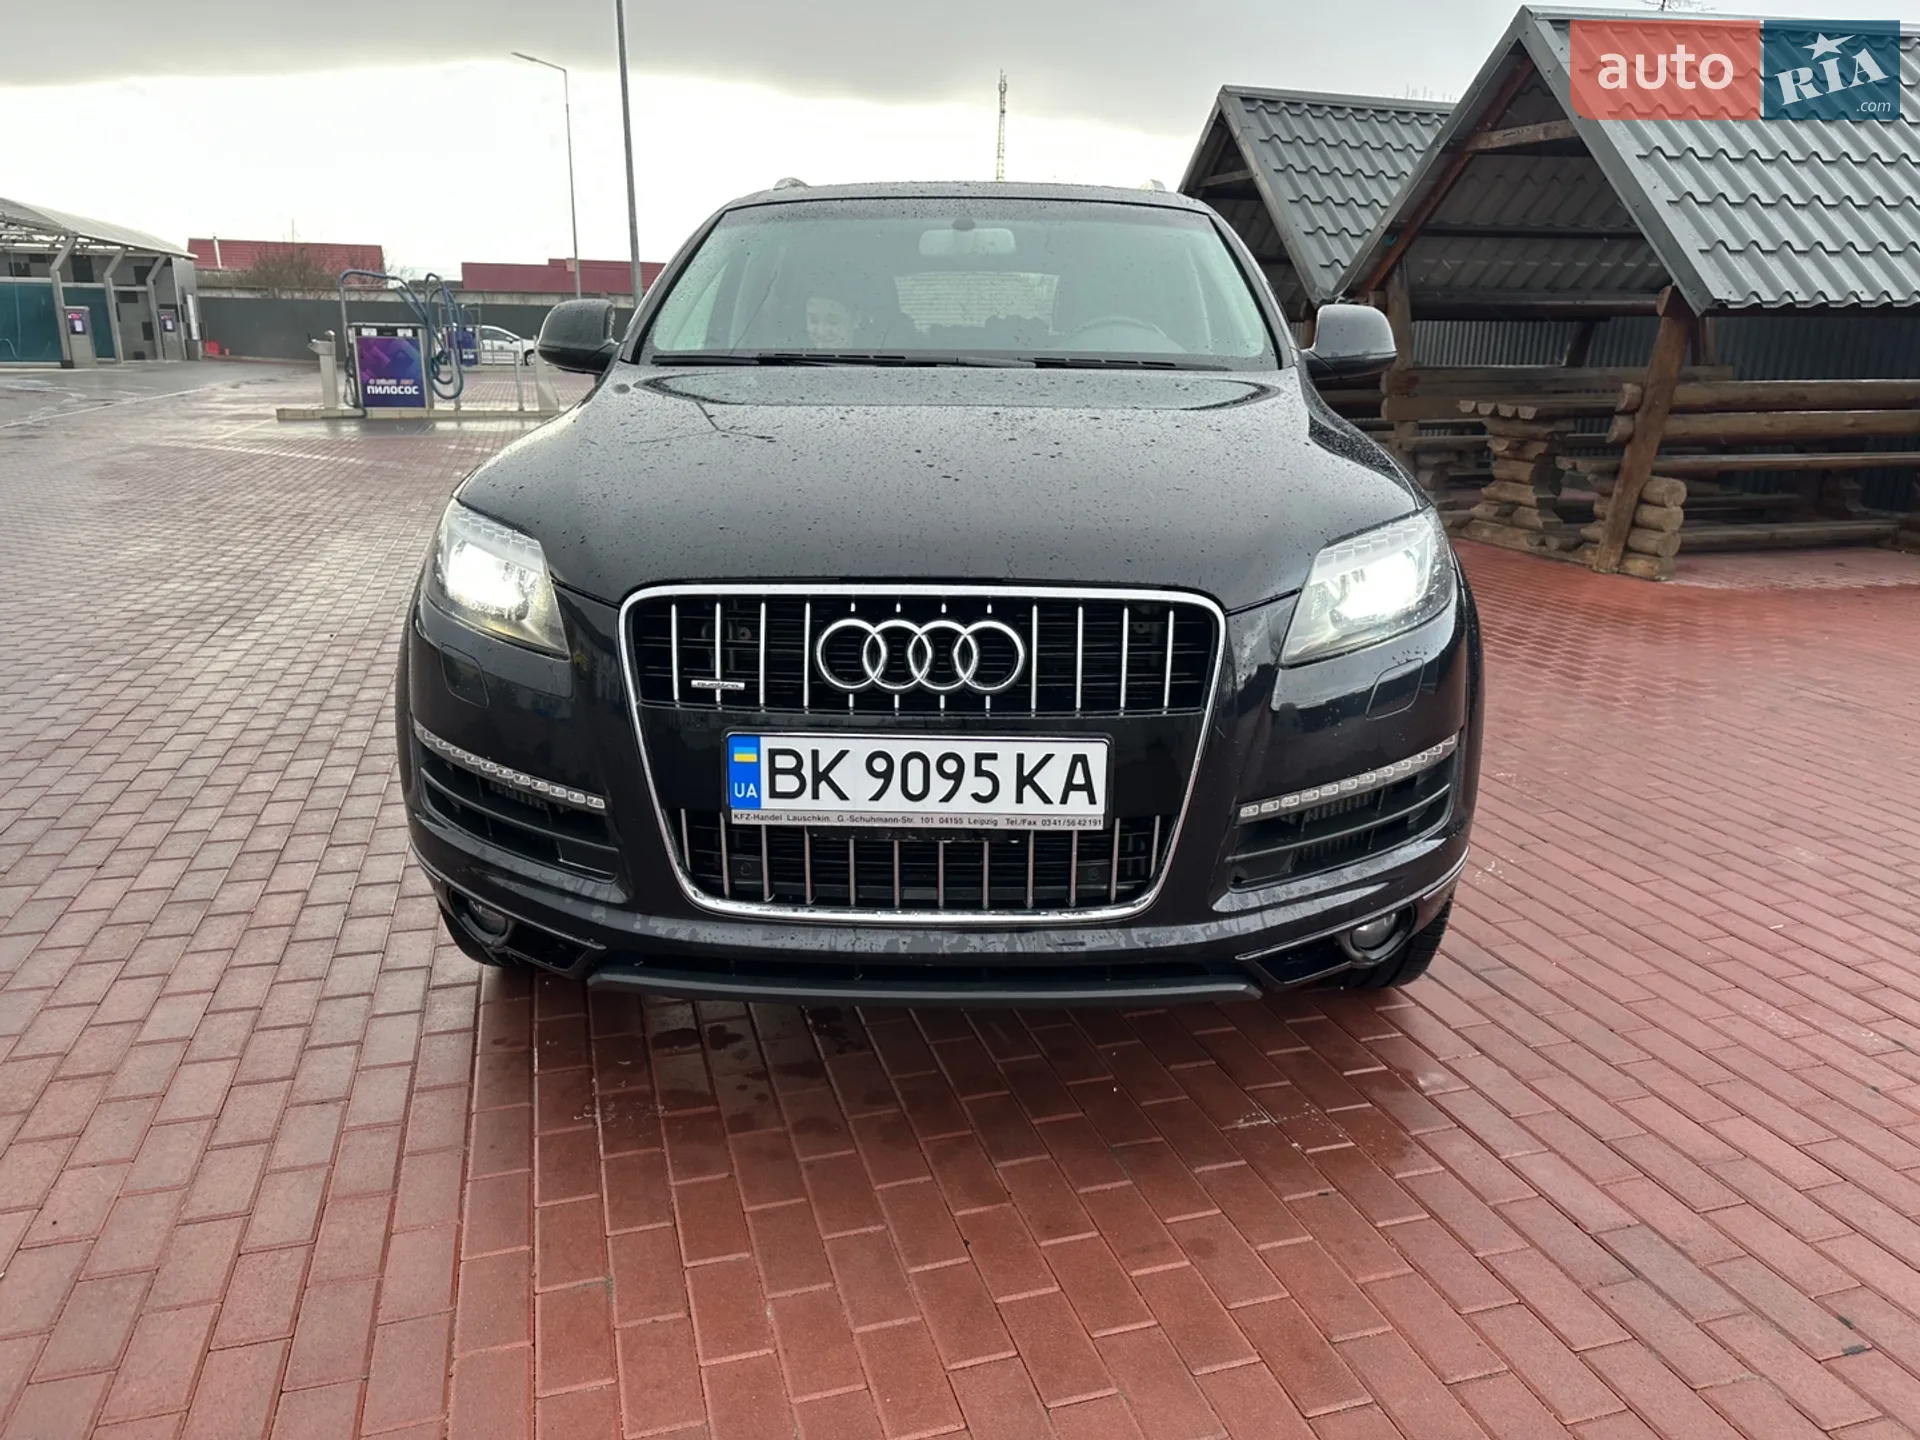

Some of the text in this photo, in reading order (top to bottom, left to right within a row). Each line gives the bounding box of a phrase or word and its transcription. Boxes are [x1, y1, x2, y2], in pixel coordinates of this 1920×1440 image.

[366, 386, 420, 395] ПИЛОСОС
[767, 748, 1097, 805] BK 9095 KA
[734, 782, 758, 798] UA
[733, 813, 783, 821] KFZ-Handel
[938, 817, 964, 825] 04155
[968, 817, 999, 827] Leipzig
[1006, 818, 1037, 827] Tel./Fax
